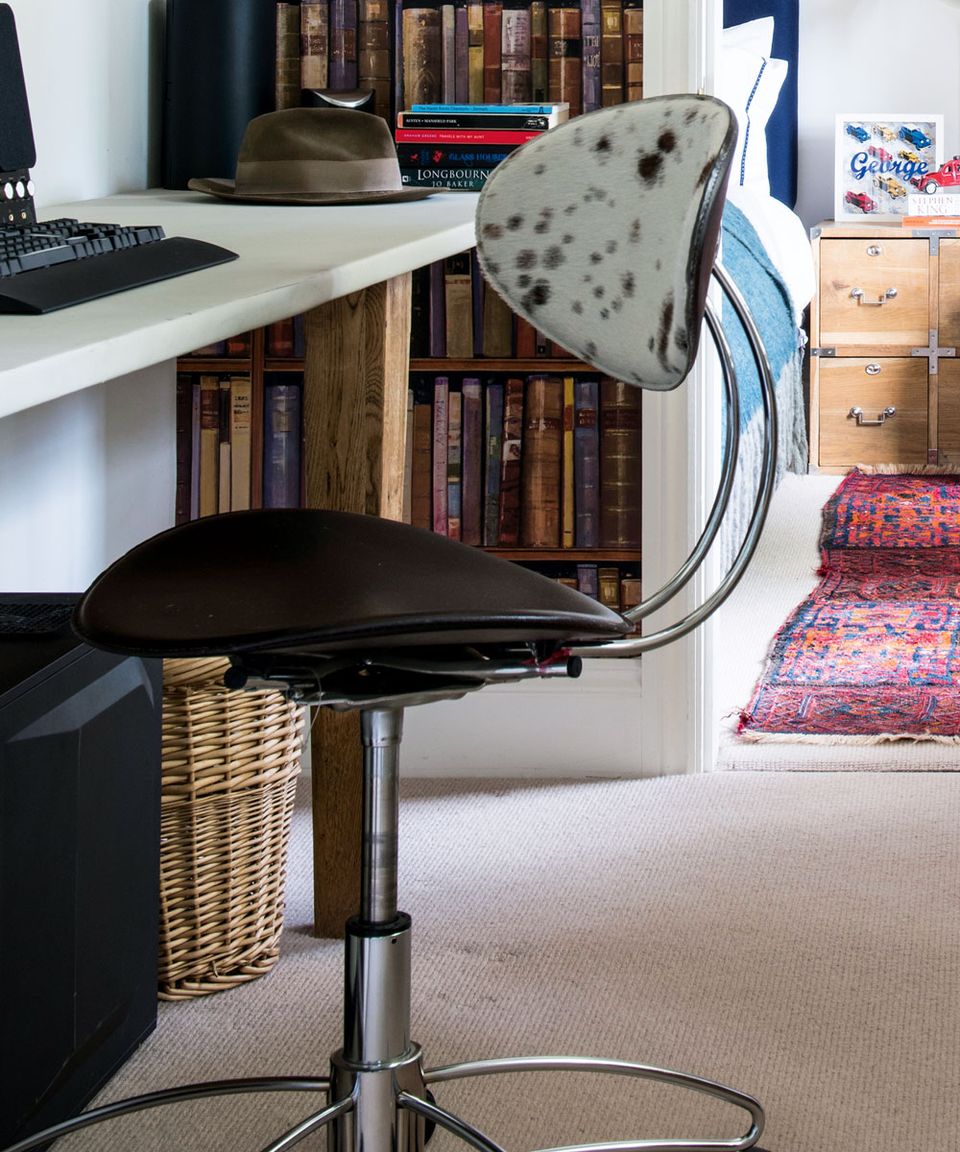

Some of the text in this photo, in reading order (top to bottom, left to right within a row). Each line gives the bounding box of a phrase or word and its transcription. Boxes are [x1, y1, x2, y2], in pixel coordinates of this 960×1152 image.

[448, 152, 475, 161] GLASS
[850, 151, 929, 181] George
[417, 169, 491, 181] LONGBOURN
[911, 196, 953, 205] STEPHEN
[917, 205, 949, 215] KING
